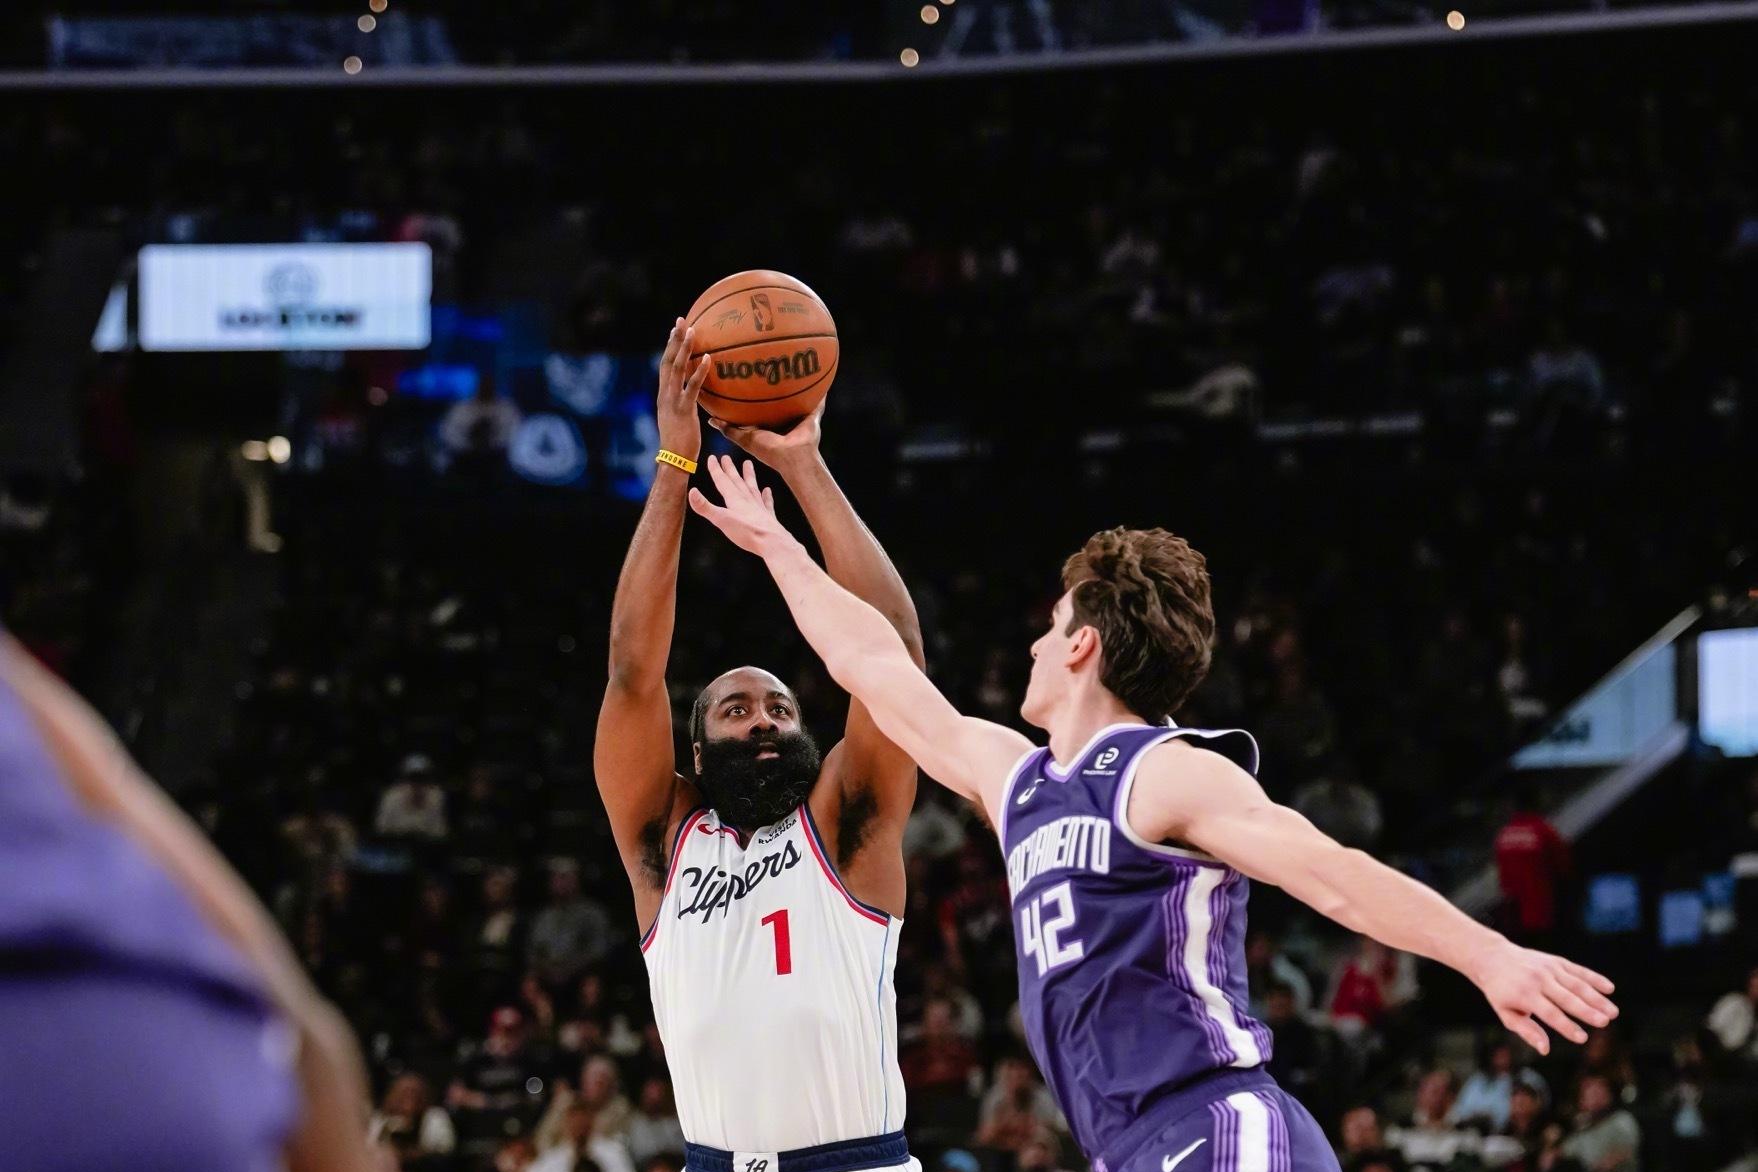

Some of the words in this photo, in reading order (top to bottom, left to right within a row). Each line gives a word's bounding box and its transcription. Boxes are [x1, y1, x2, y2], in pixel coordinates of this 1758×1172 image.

[714, 347, 821, 385] Wilson
[758, 818, 797, 844] RWANDA
[677, 839, 802, 924] Clippers
[761, 908, 792, 976] 1
[1021, 880, 1085, 979] 42
